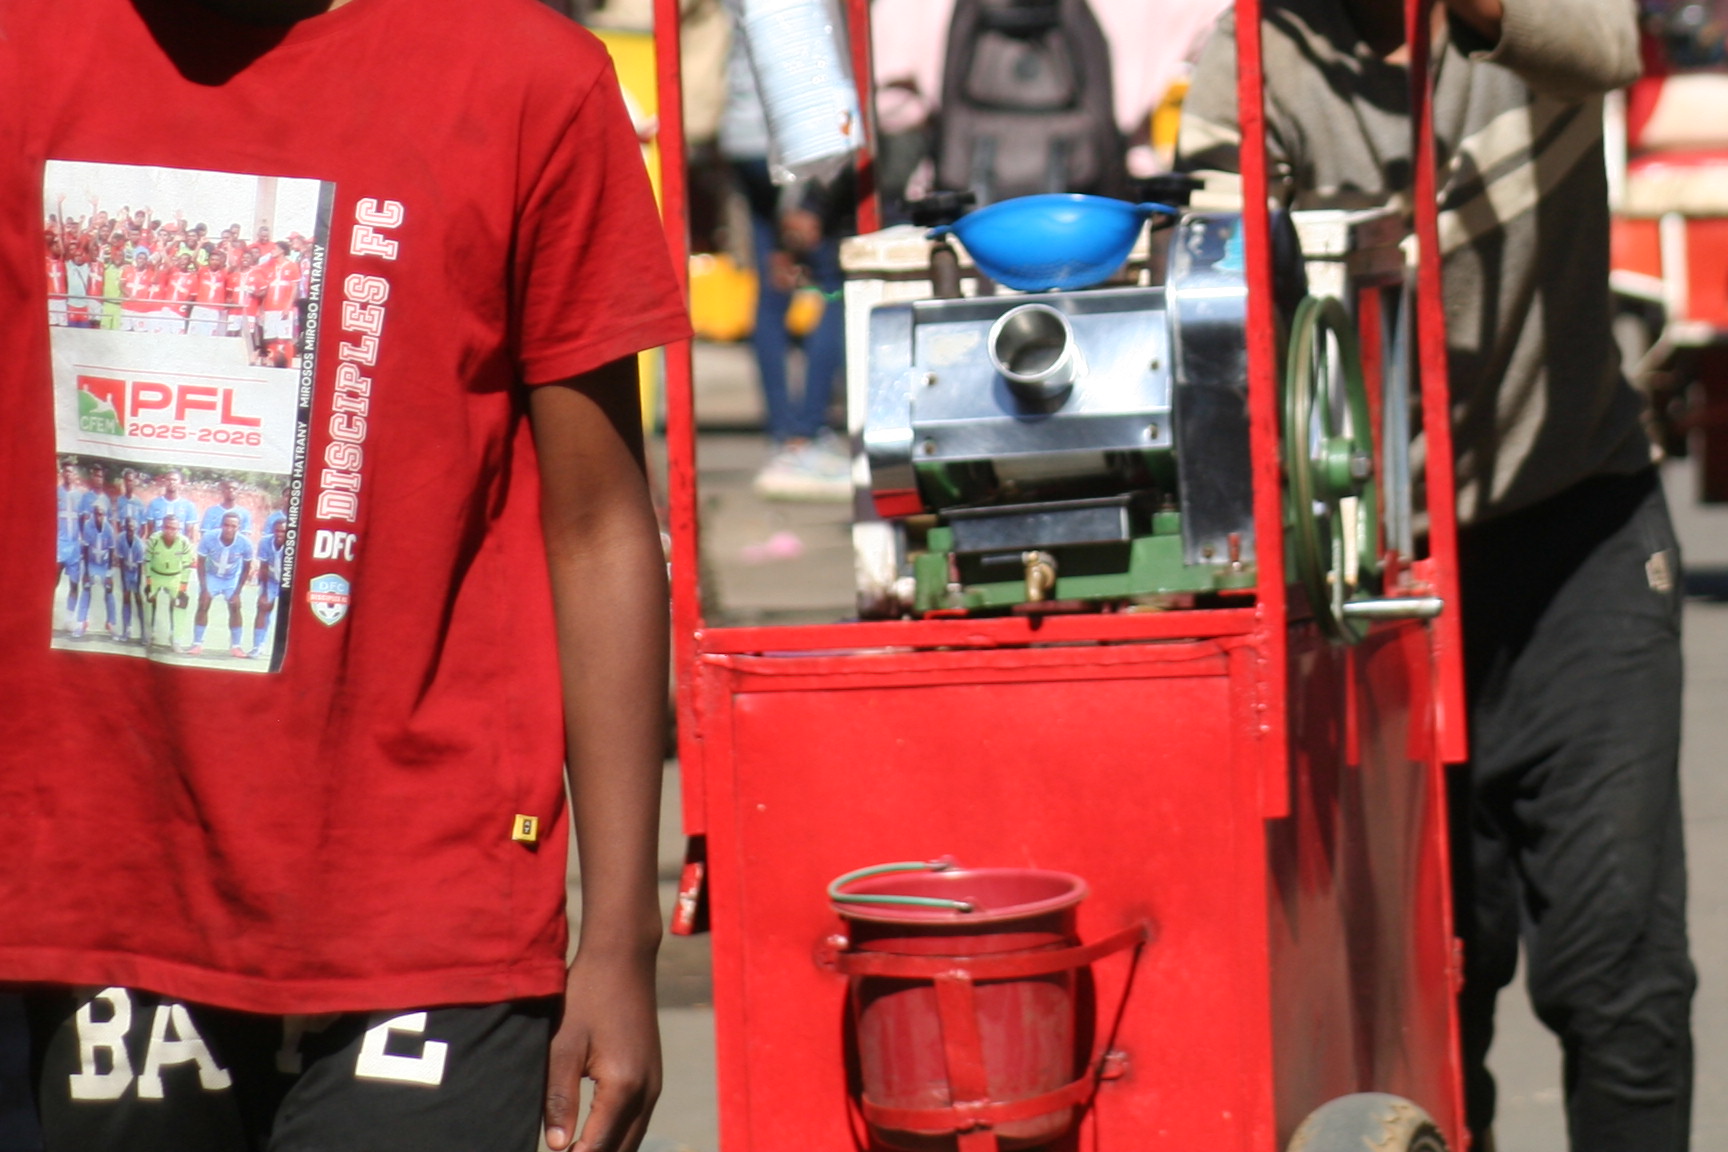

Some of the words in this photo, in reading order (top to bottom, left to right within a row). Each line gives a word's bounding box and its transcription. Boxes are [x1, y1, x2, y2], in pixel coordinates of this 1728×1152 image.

[350, 197, 404, 261] FC
[309, 244, 325, 301] HATRANY
[304, 302, 318, 351] MIROSO
[130, 380, 262, 428] PFL
[316, 274, 390, 524] DISCIPLES
[80, 415, 116, 434] CFEM
[127, 422, 262, 447] 2025-2026
[293, 421, 309, 478] HATRANY
[288, 479, 303, 528] MIROSO
[313, 529, 357, 562] DFC
